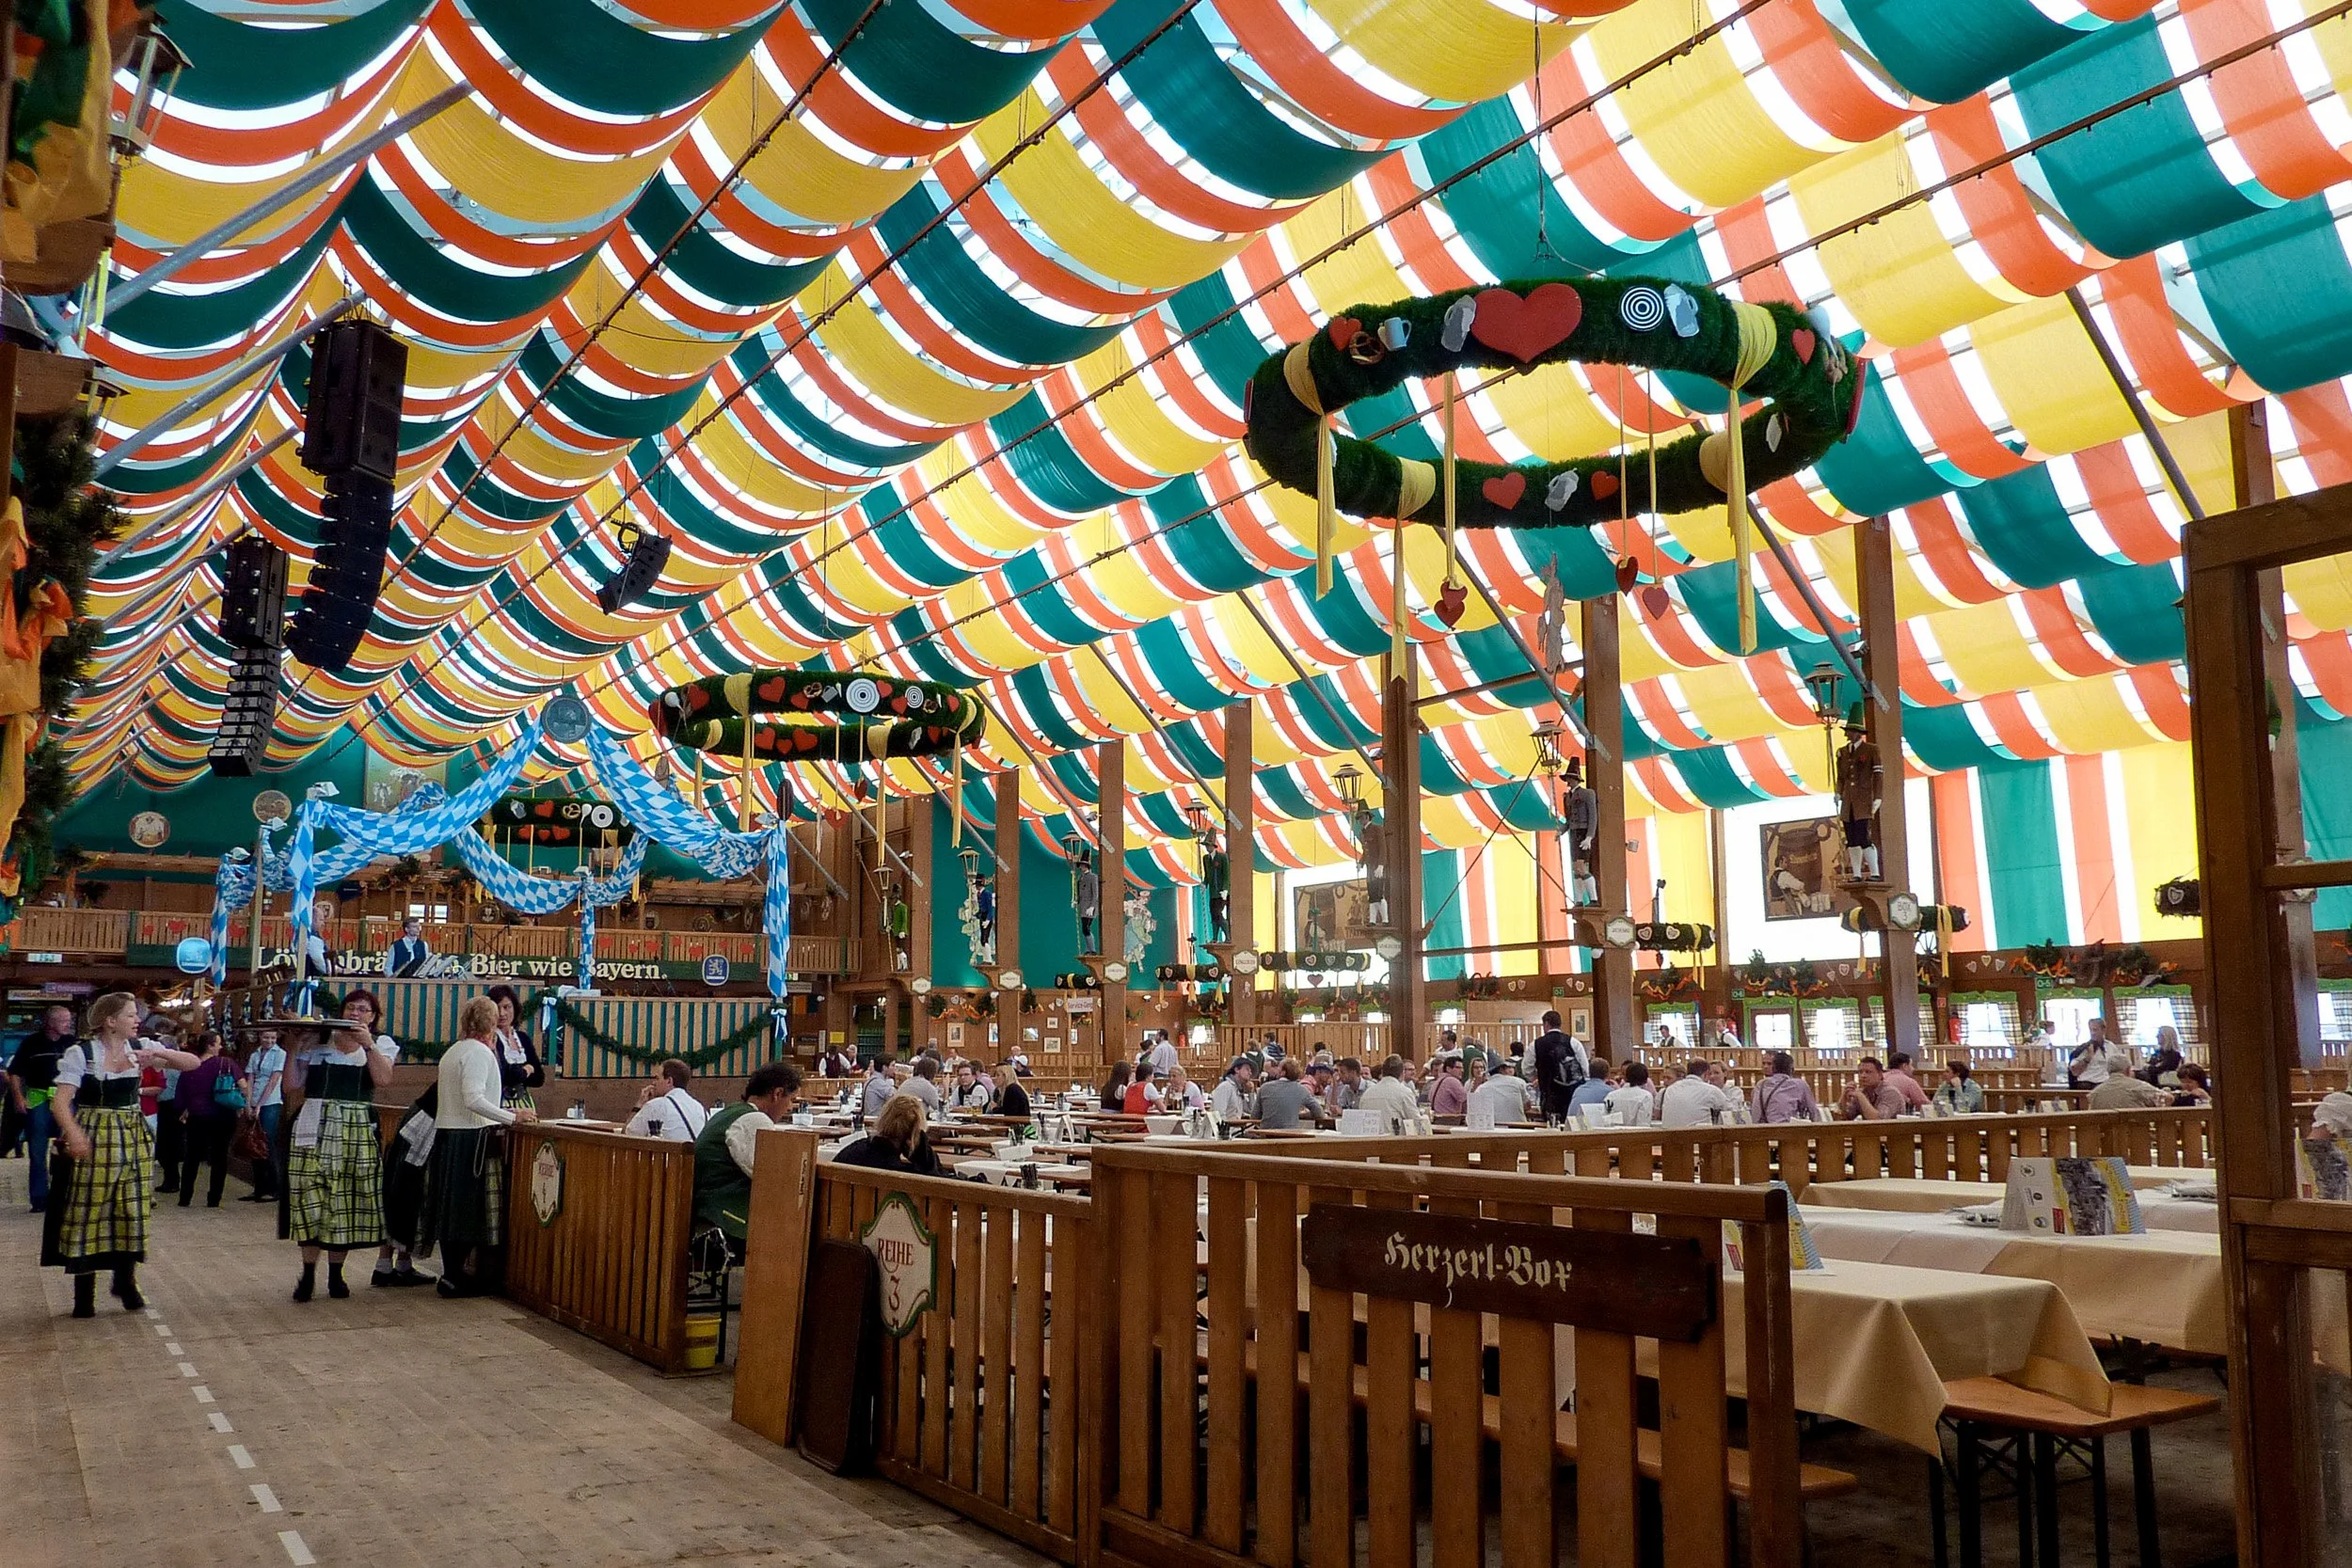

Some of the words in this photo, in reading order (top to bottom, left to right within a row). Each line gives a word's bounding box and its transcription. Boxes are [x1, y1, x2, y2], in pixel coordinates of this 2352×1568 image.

[1897, 901, 1911, 911] BOX
[470, 953, 523, 975] Bier
[528, 957, 572, 976] wie
[878, 1238, 914, 1269] REIHE
[1384, 1231, 1572, 1308] Herzerl-Box
[888, 1275, 900, 1311] 3
